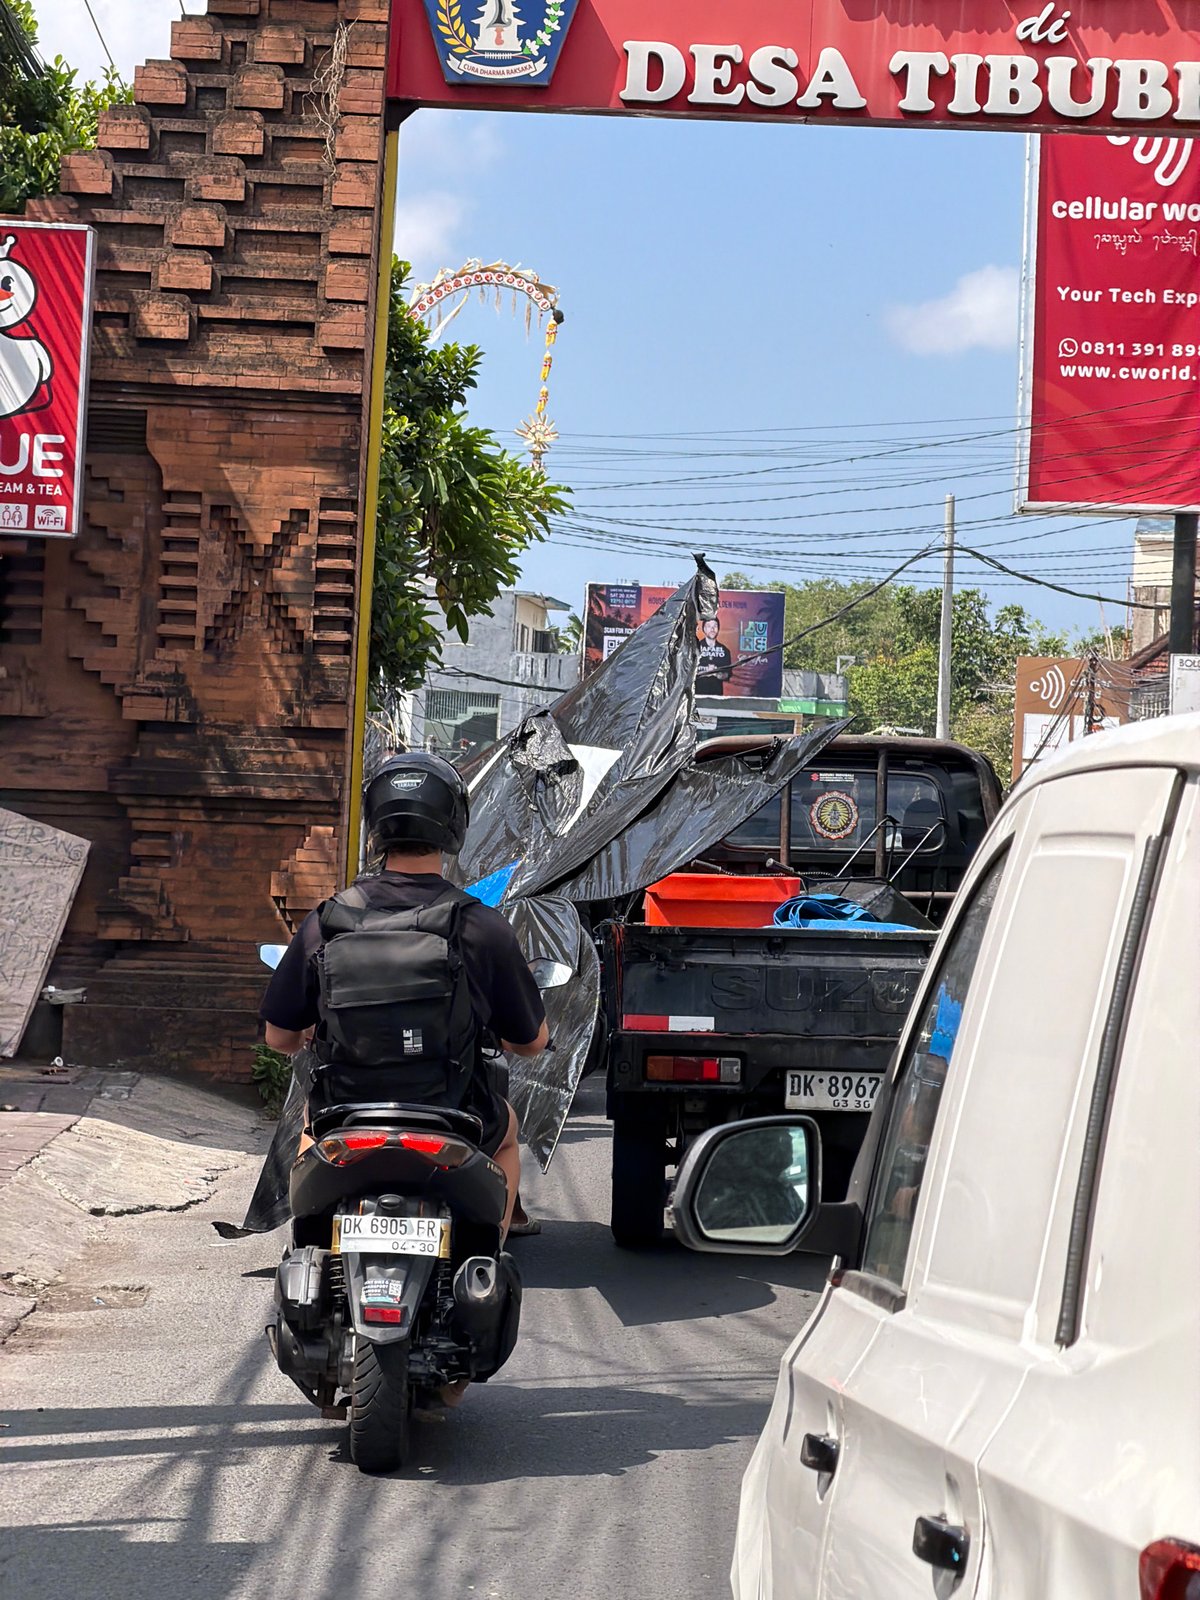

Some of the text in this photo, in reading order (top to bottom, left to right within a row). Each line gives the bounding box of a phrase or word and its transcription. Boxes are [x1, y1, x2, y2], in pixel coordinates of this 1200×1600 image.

[1015, 1, 1071, 44] di
[463, 63, 533, 76] CURA DHARMA RAKSAKA
[619, 40, 868, 111] DESA
[1051, 196, 1157, 220] cellular
[1056, 286, 1200, 308] Your Tech Exp
[1081, 341, 1125, 356] 0811
[1131, 343, 1164, 357] 391
[1060, 364, 1197, 381] www.cworld.
[26, 483, 35, 494] &
[38, 484, 63, 496] TEA
[37, 516, 64, 526] Wi-Fi
[789, 1073, 882, 1099] DK 8967
[343, 1217, 436, 1237] DK 6905 FR
[391, 1241, 435, 1253] 04 30
